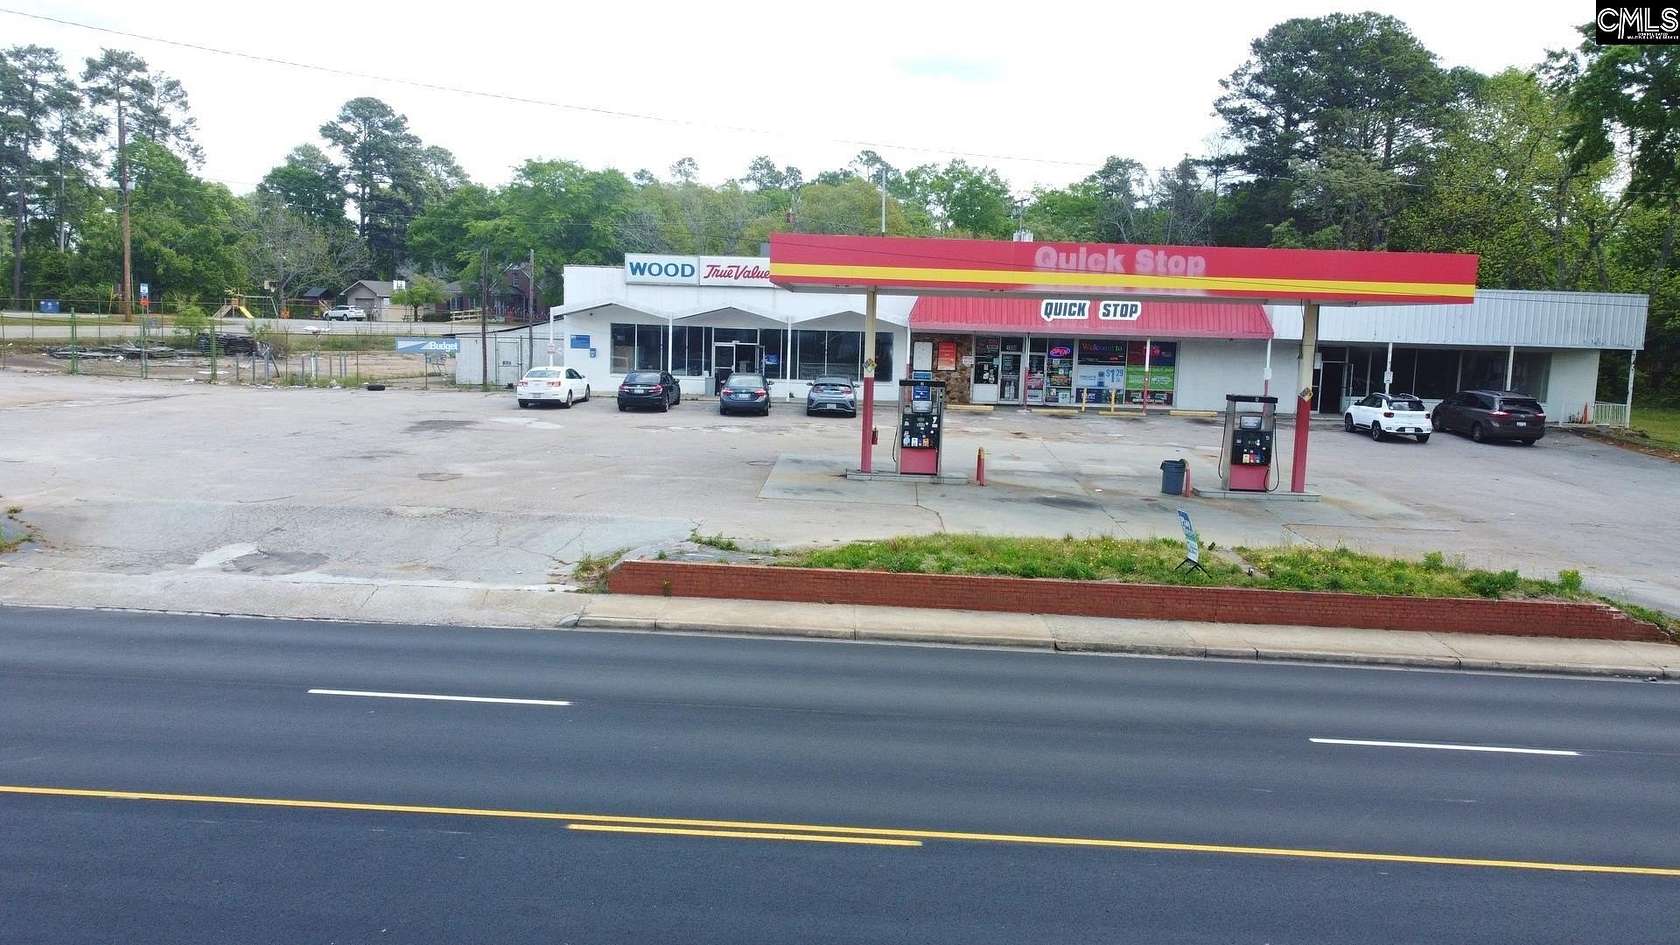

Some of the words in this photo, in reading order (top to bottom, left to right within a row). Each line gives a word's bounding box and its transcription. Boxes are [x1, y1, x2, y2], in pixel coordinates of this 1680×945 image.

[1034, 245, 1126, 273] Quick
[1135, 249, 1206, 277] Stop
[629, 262, 696, 278] WOOD
[1043, 302, 1088, 318] QUICK
[1102, 303, 1139, 317] STOP
[431, 341, 458, 352] Budget
